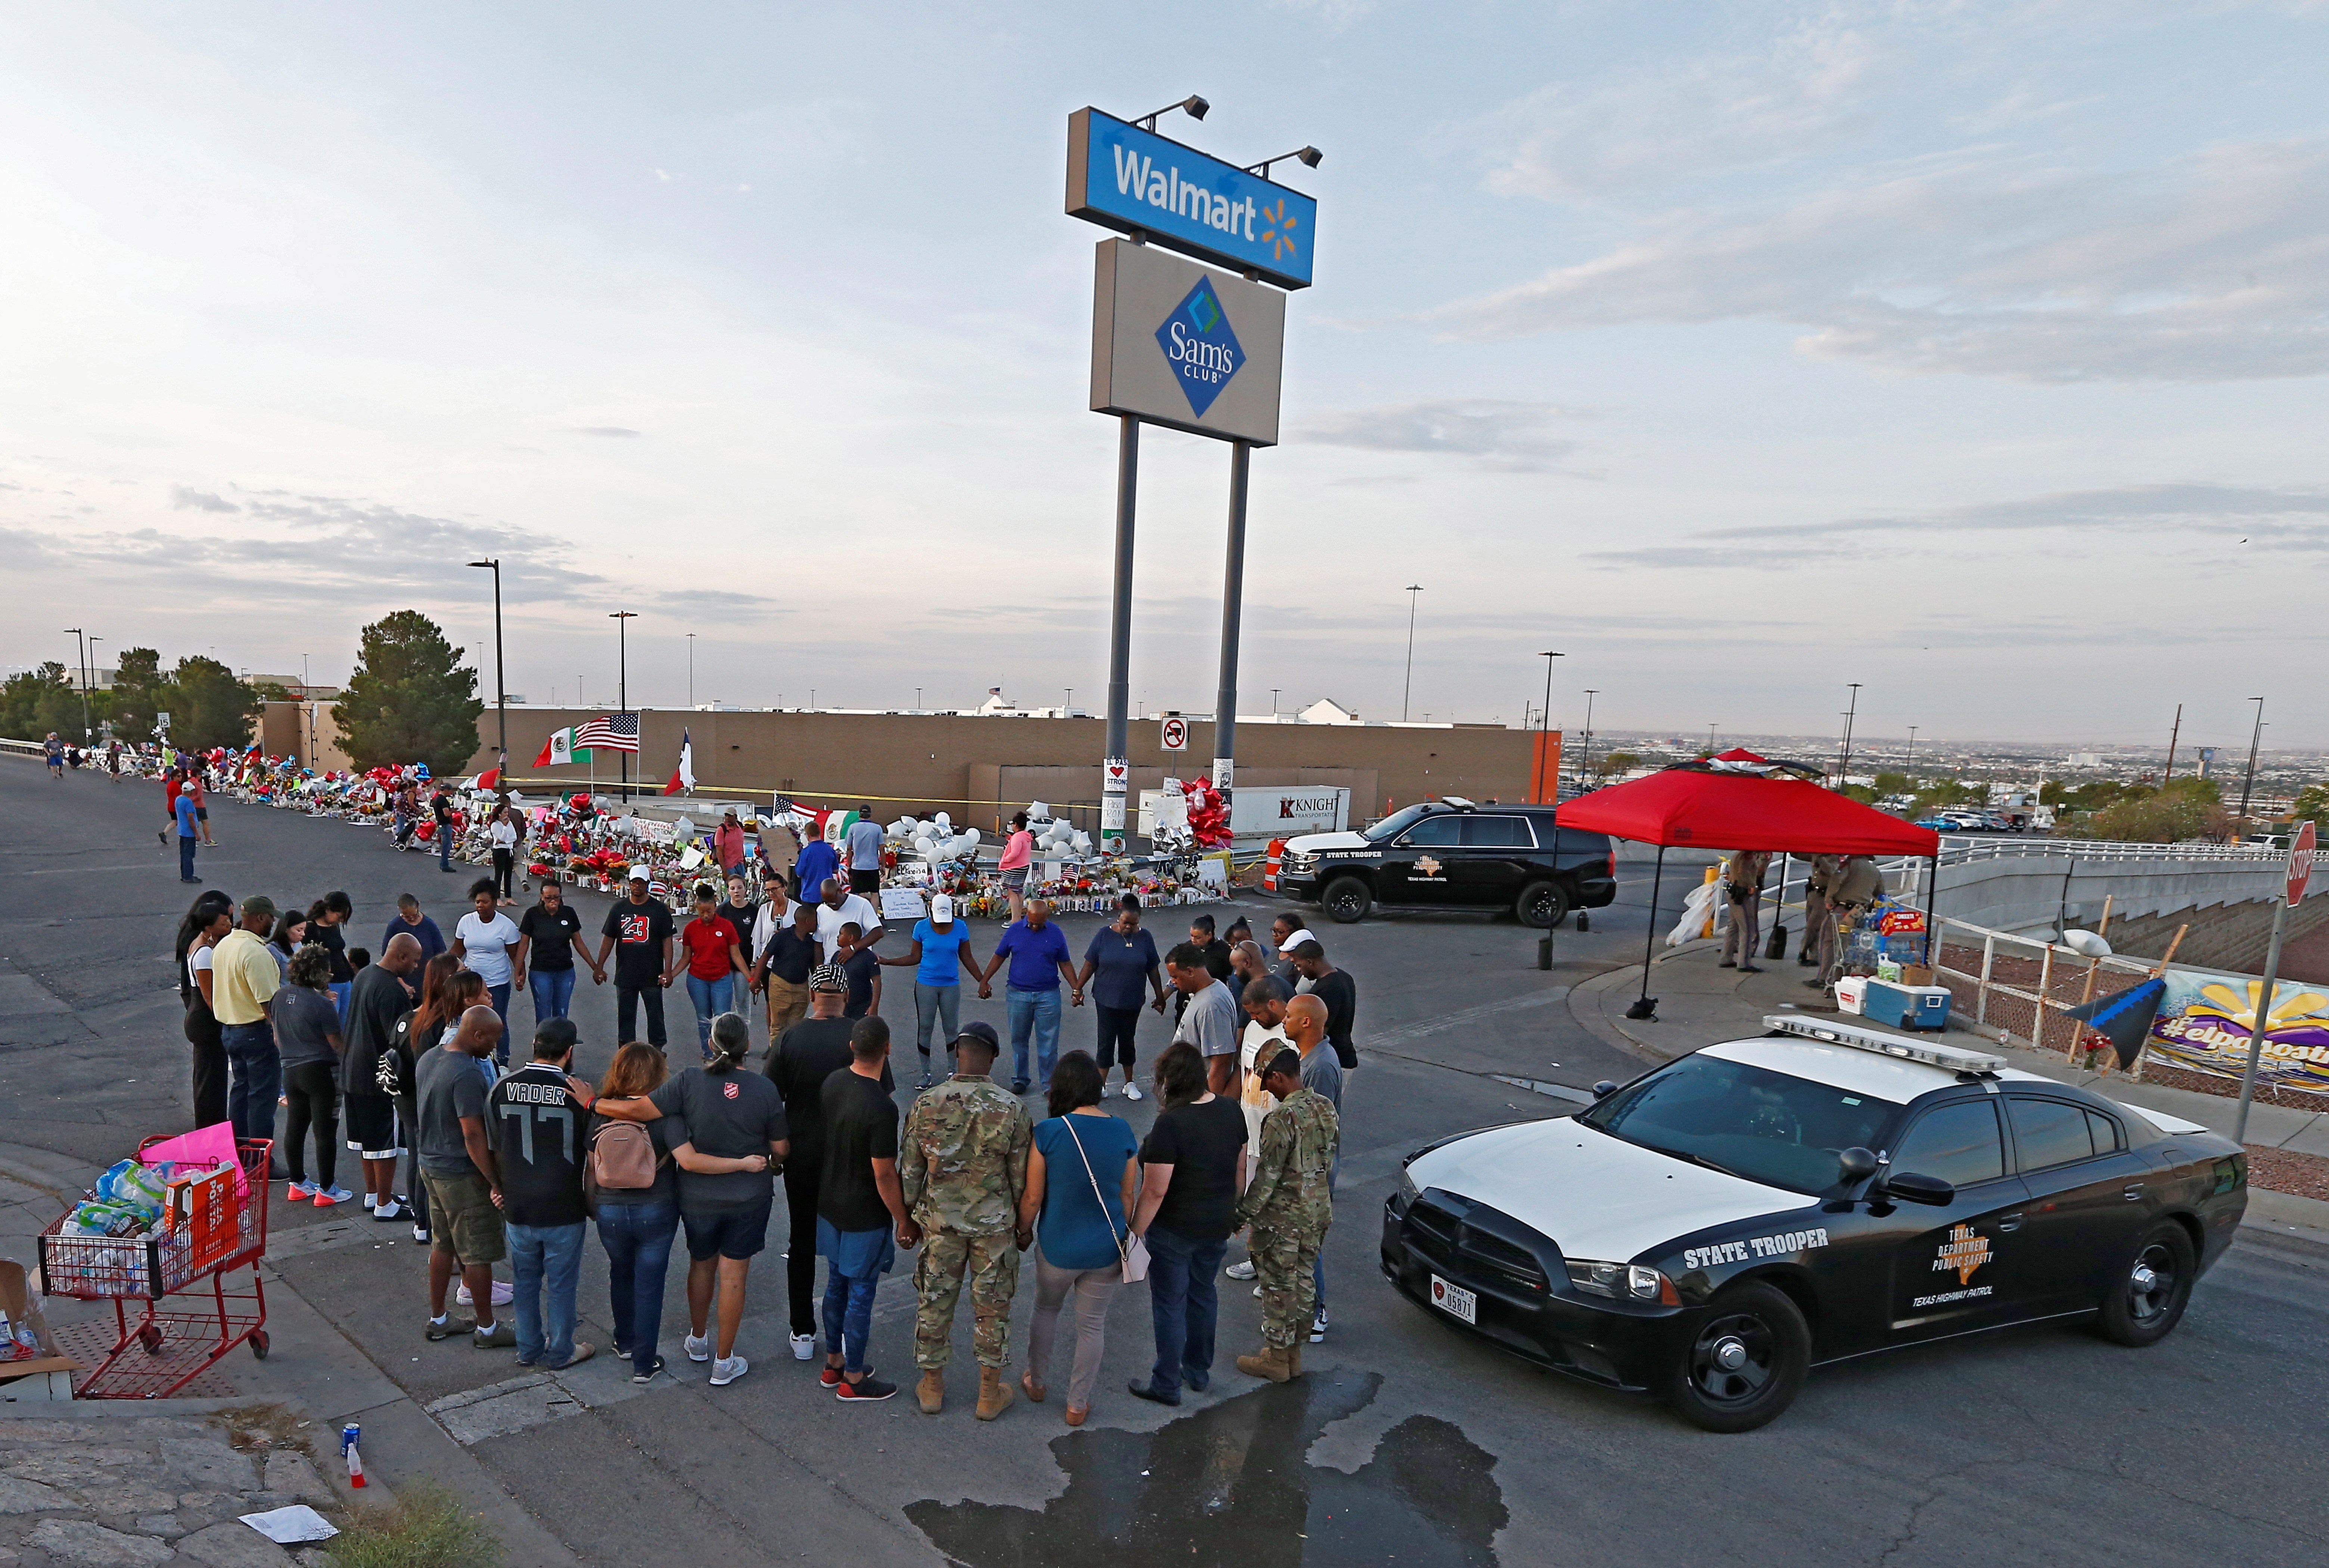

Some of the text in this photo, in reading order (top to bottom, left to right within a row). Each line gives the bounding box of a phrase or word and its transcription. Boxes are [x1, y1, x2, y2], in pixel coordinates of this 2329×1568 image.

[1114, 143, 1256, 242] Walmart
[1169, 321, 1232, 374] Sam's
[1184, 364, 1218, 383] CLUB
[2289, 848, 2313, 880] STOP
[621, 914, 650, 943] 23
[506, 1082, 566, 1105] VADER
[500, 1104, 574, 1165] 77
[1949, 1227, 1975, 1241] TEXAS
[1683, 1227, 1829, 1269] STATE TROOPER
[1938, 1239, 1989, 1257] DEPARTMENT
[1932, 1251, 1993, 1271] PUBLIC SAFETY
[1446, 1283, 1464, 1297] TEXAS
[1913, 1286, 1992, 1307] TEXAS HIGHWAY PATROL
[1448, 1294, 1471, 1317] 05871
